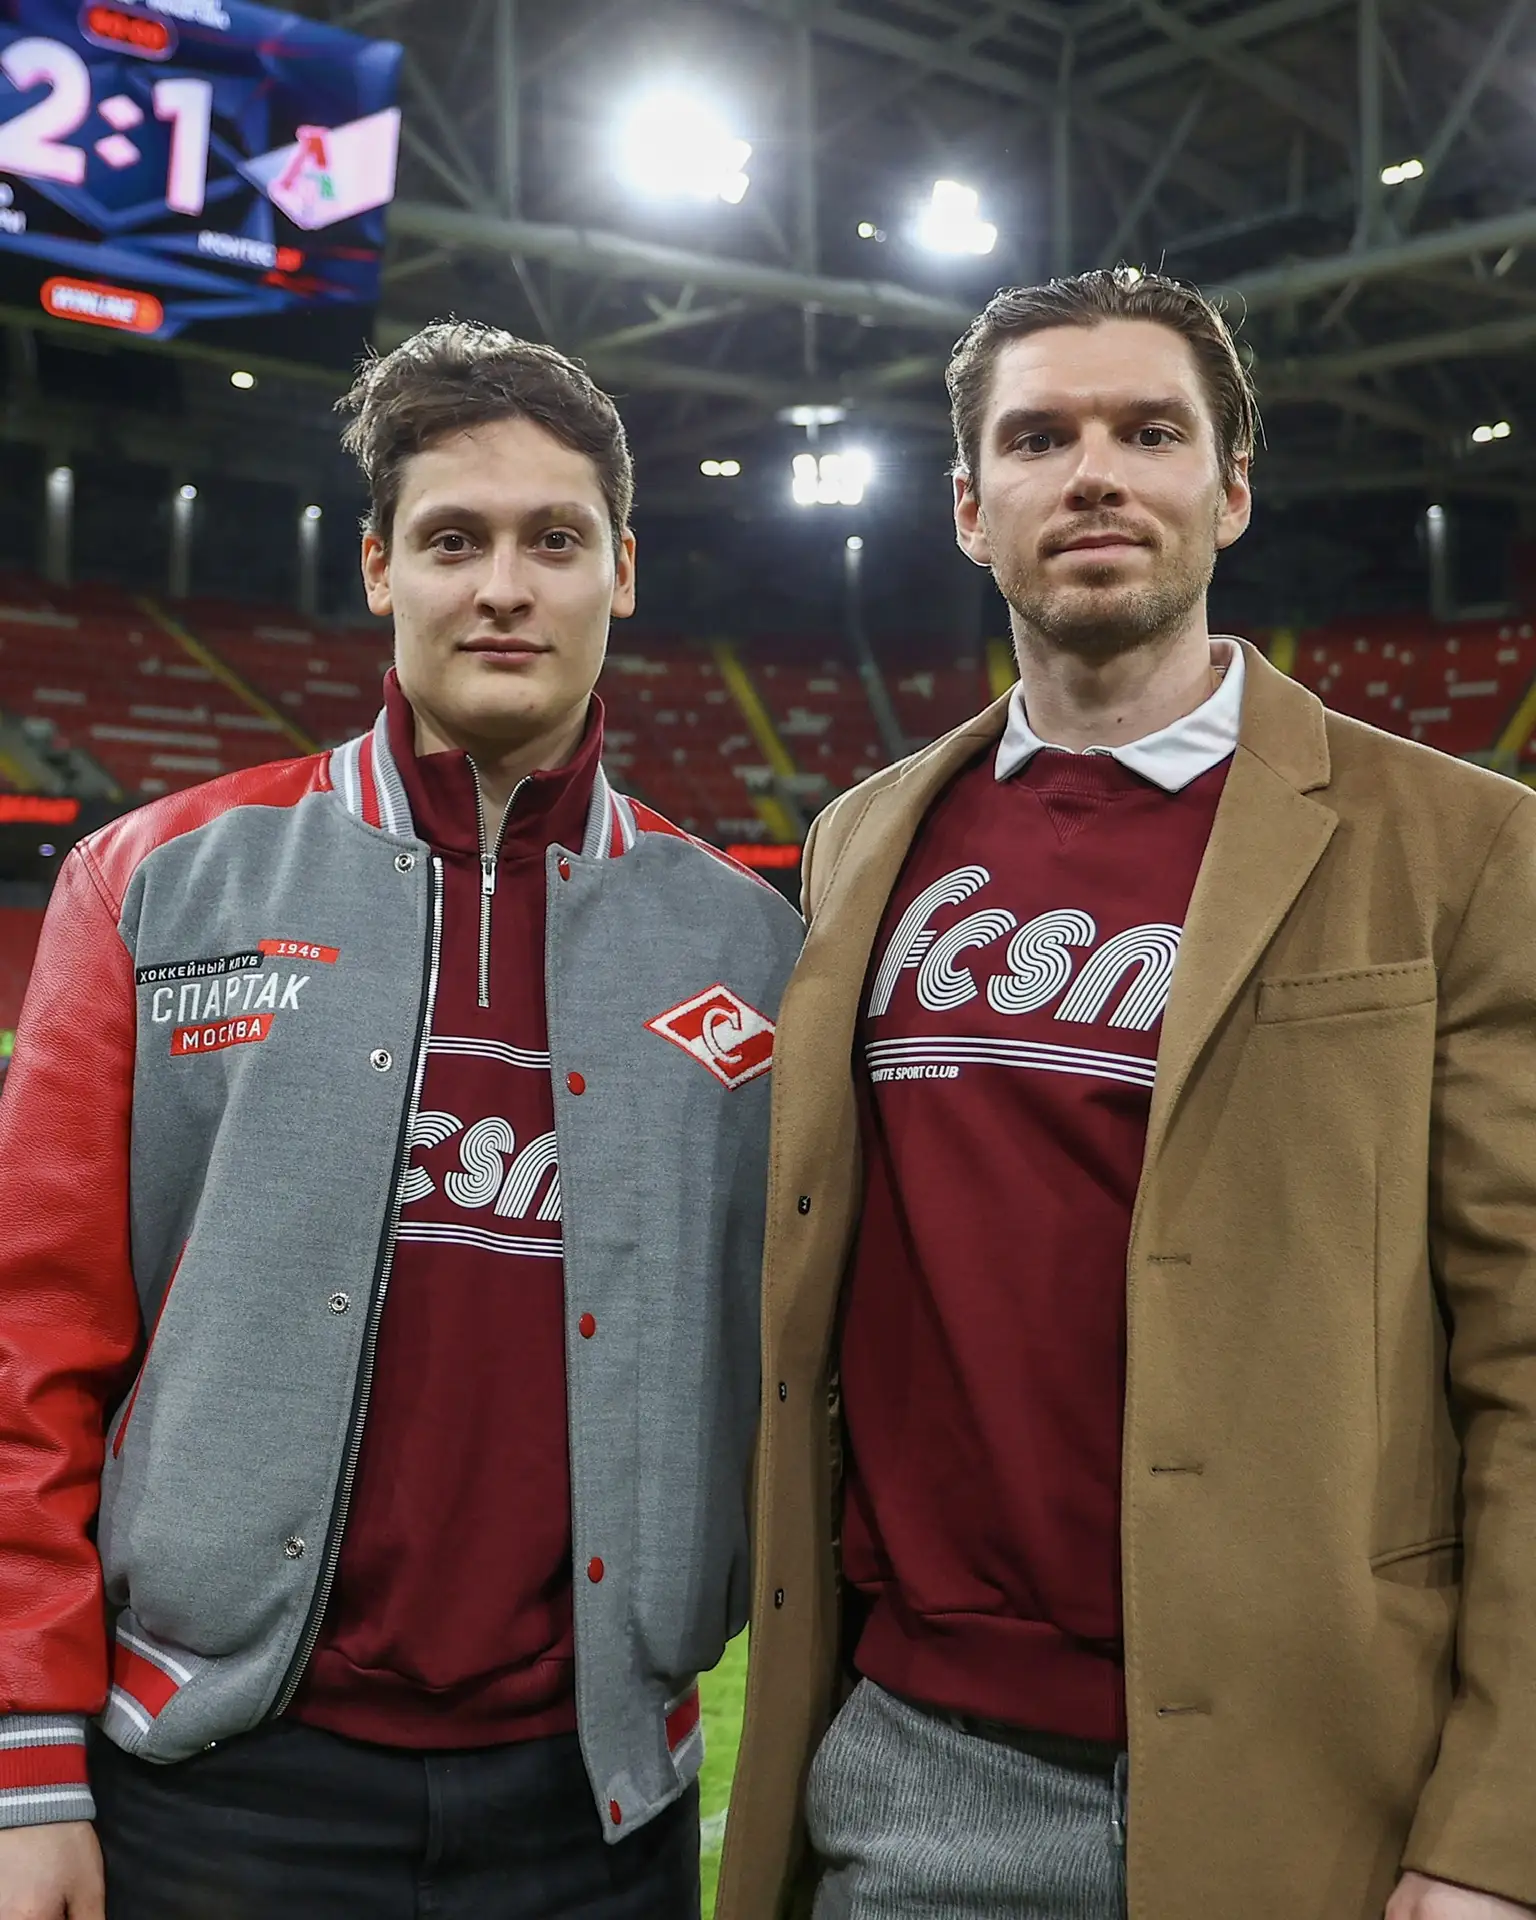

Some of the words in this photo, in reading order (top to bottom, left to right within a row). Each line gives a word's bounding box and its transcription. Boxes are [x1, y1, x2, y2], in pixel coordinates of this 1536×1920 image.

[277, 942, 321, 958] 1946
[139, 958, 226, 983] ХОККЕЙНЫЙ
[228, 955, 259, 972] КЛУБ
[151, 972, 311, 1023] СПАРТАК
[182, 1018, 261, 1050] МОСКВА
[895, 1065, 925, 1081] SPORT
[925, 1065, 960, 1079] CLUB
